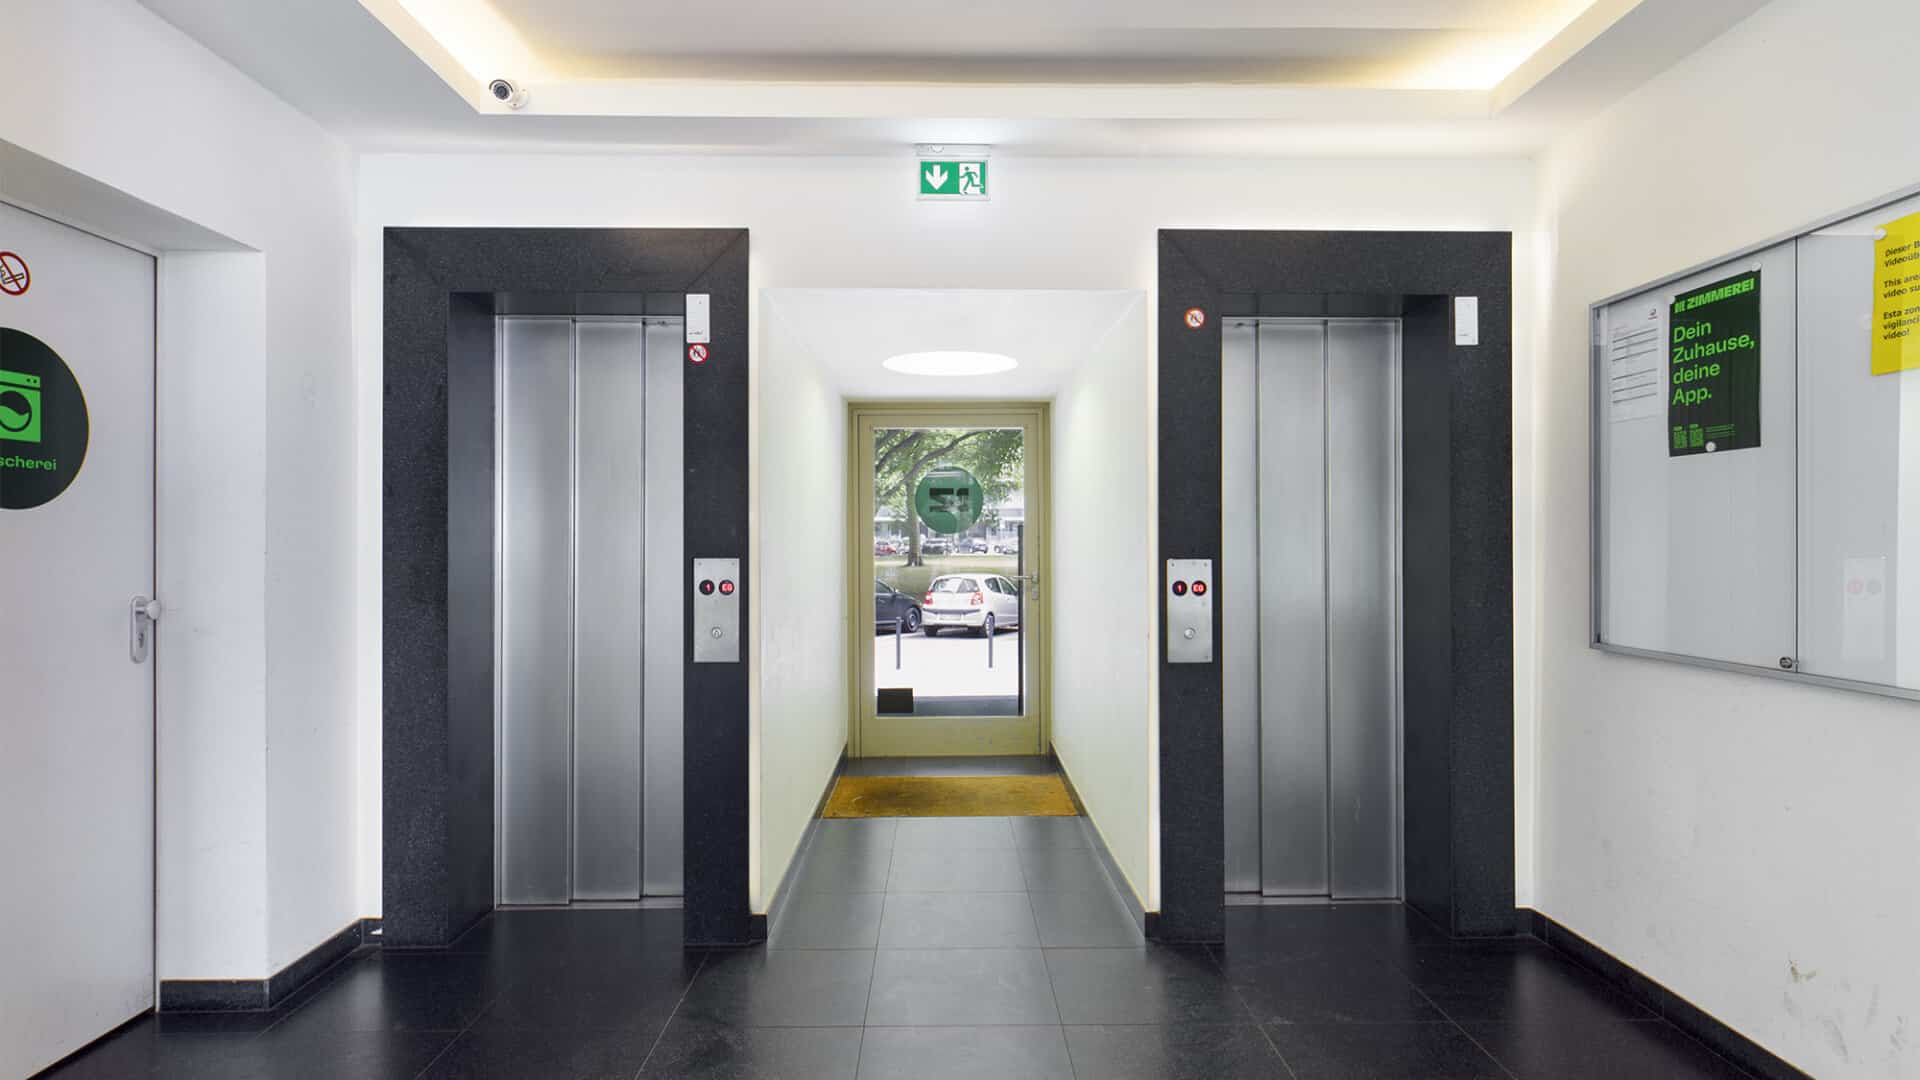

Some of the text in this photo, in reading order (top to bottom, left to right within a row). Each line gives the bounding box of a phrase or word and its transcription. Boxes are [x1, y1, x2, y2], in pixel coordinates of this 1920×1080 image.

[1885, 244, 1911, 257] Dieser
[1884, 278, 1902, 288] This
[1686, 278, 1755, 310] ZIMMEREI
[1883, 288, 1907, 299] video
[1883, 309, 1902, 320] Esta
[1674, 321, 1712, 344] Dein
[1883, 329, 1910, 340] video!
[1672, 334, 1755, 364] Zuhause,
[1673, 363, 1721, 385] deine
[1672, 387, 1712, 406] App.
